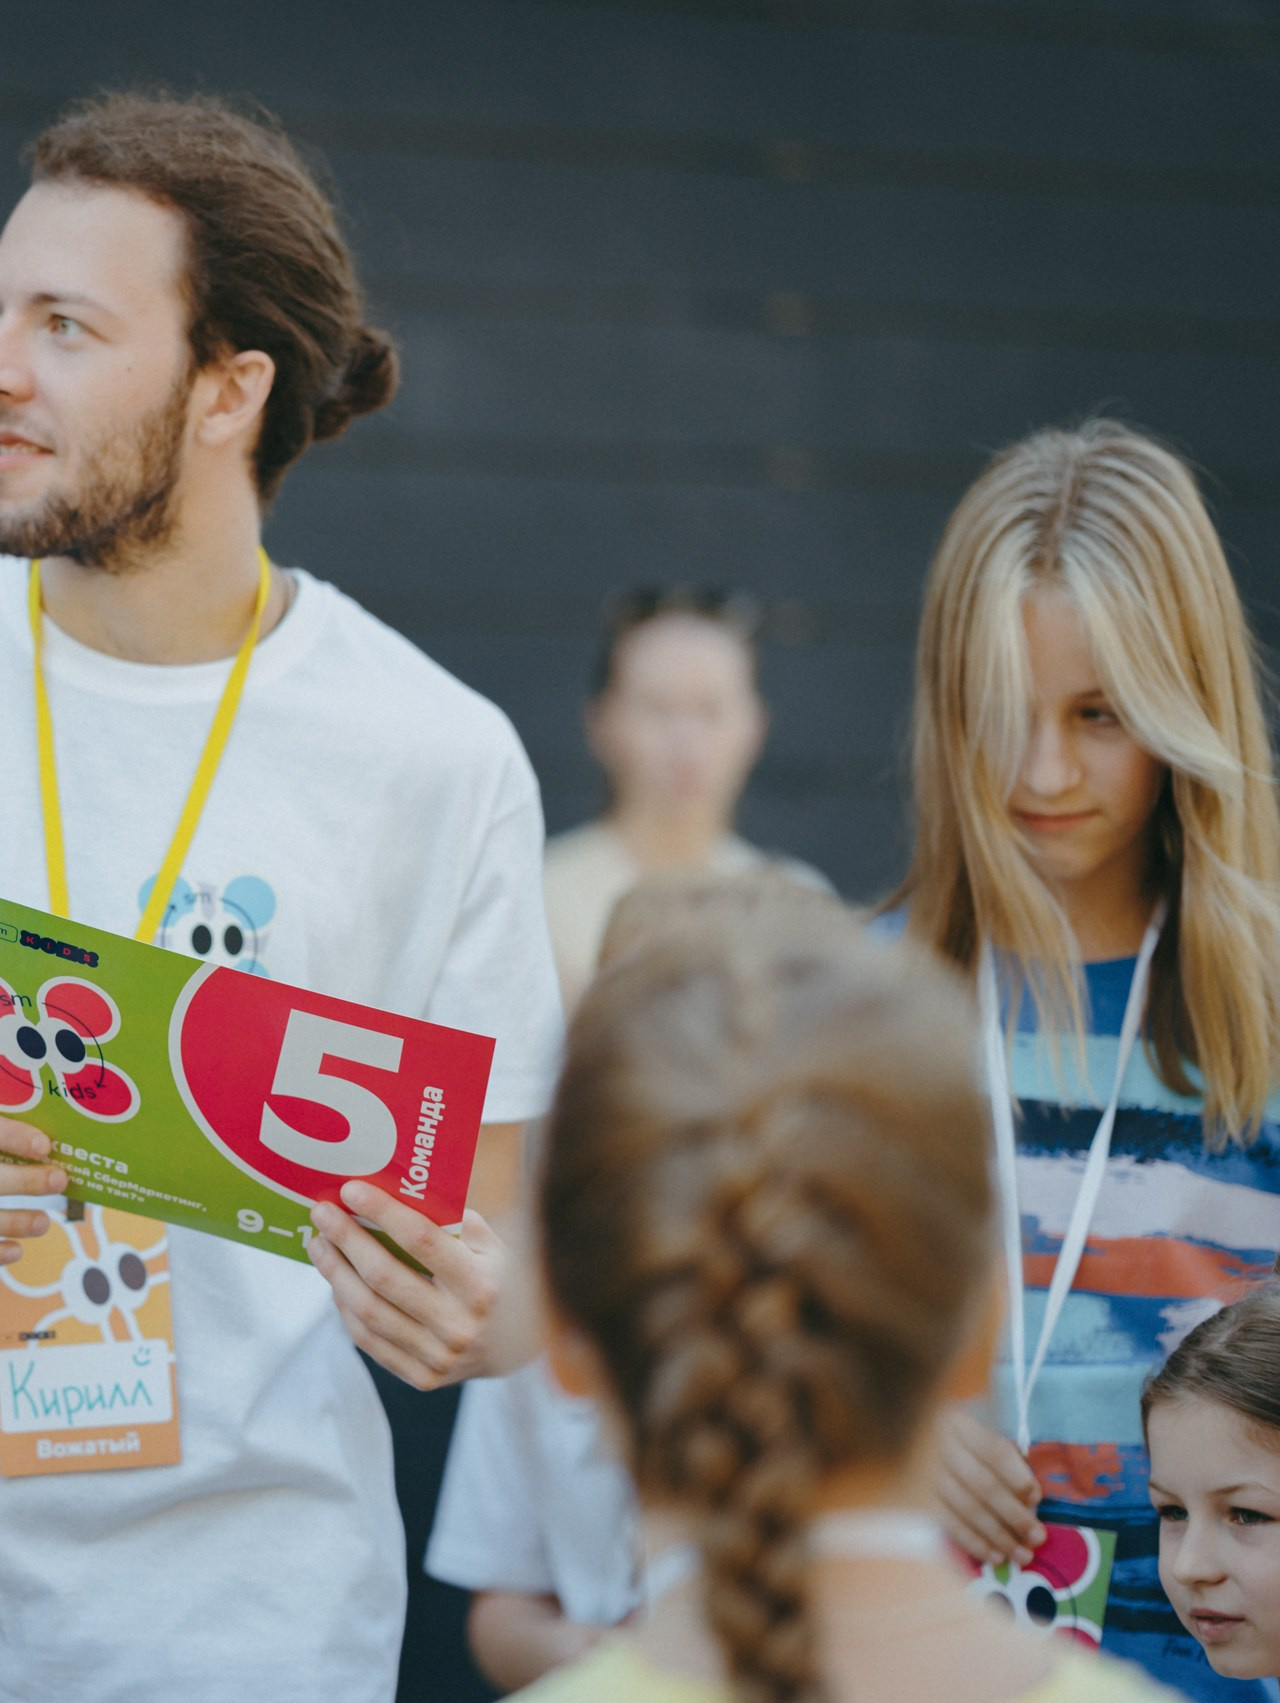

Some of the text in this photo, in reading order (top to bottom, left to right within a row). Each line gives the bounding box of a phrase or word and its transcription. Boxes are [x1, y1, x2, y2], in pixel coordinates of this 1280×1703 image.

[23, 933, 94, 965] KIDS
[0, 994, 32, 1007] sm
[48, 1080, 97, 1099] kids
[259, 1008, 404, 1176] 5
[399, 1086, 446, 1200] Команда
[8, 1360, 153, 1425] Кирилл
[36, 1430, 141, 1460] Вожатый
